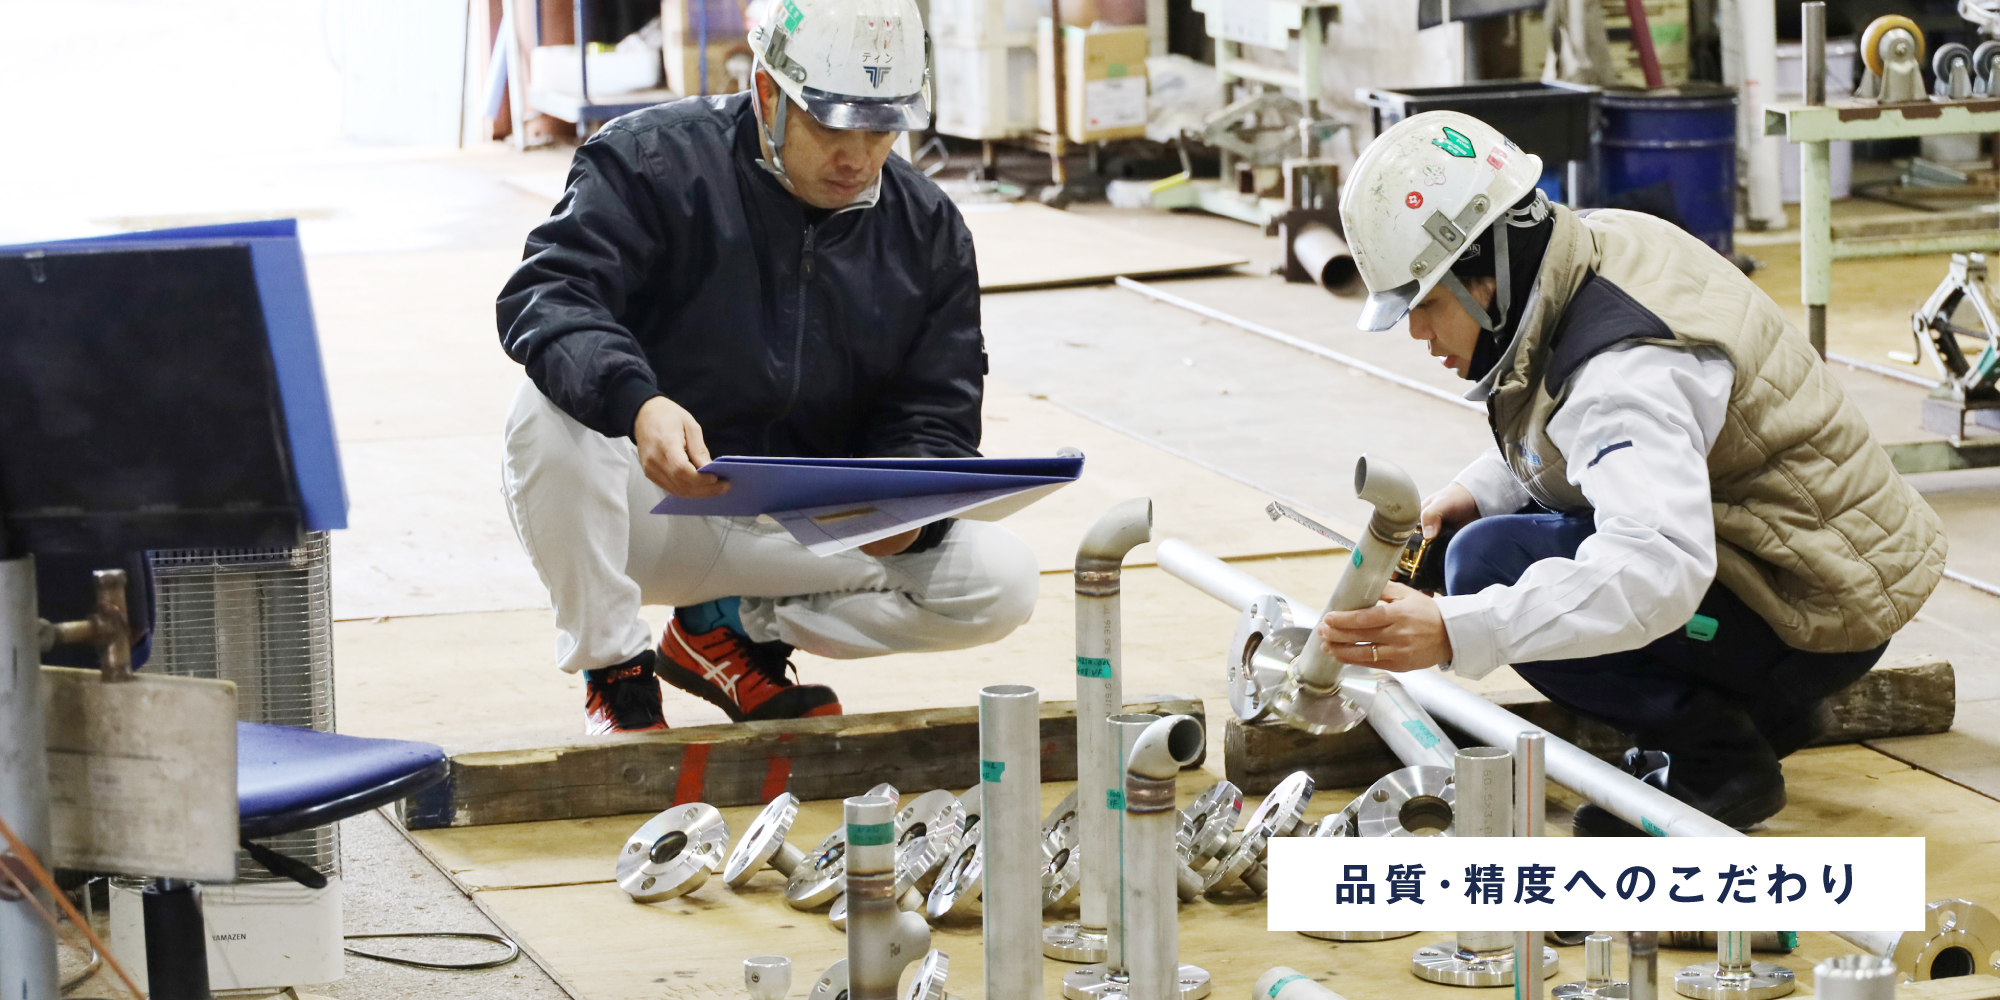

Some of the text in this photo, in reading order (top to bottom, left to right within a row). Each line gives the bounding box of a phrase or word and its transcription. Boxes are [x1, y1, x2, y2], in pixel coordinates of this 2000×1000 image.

[862, 53, 893, 63] ティン
[1103, 619, 1111, 635] 316
[212, 933, 246, 941] YAMAZEN
